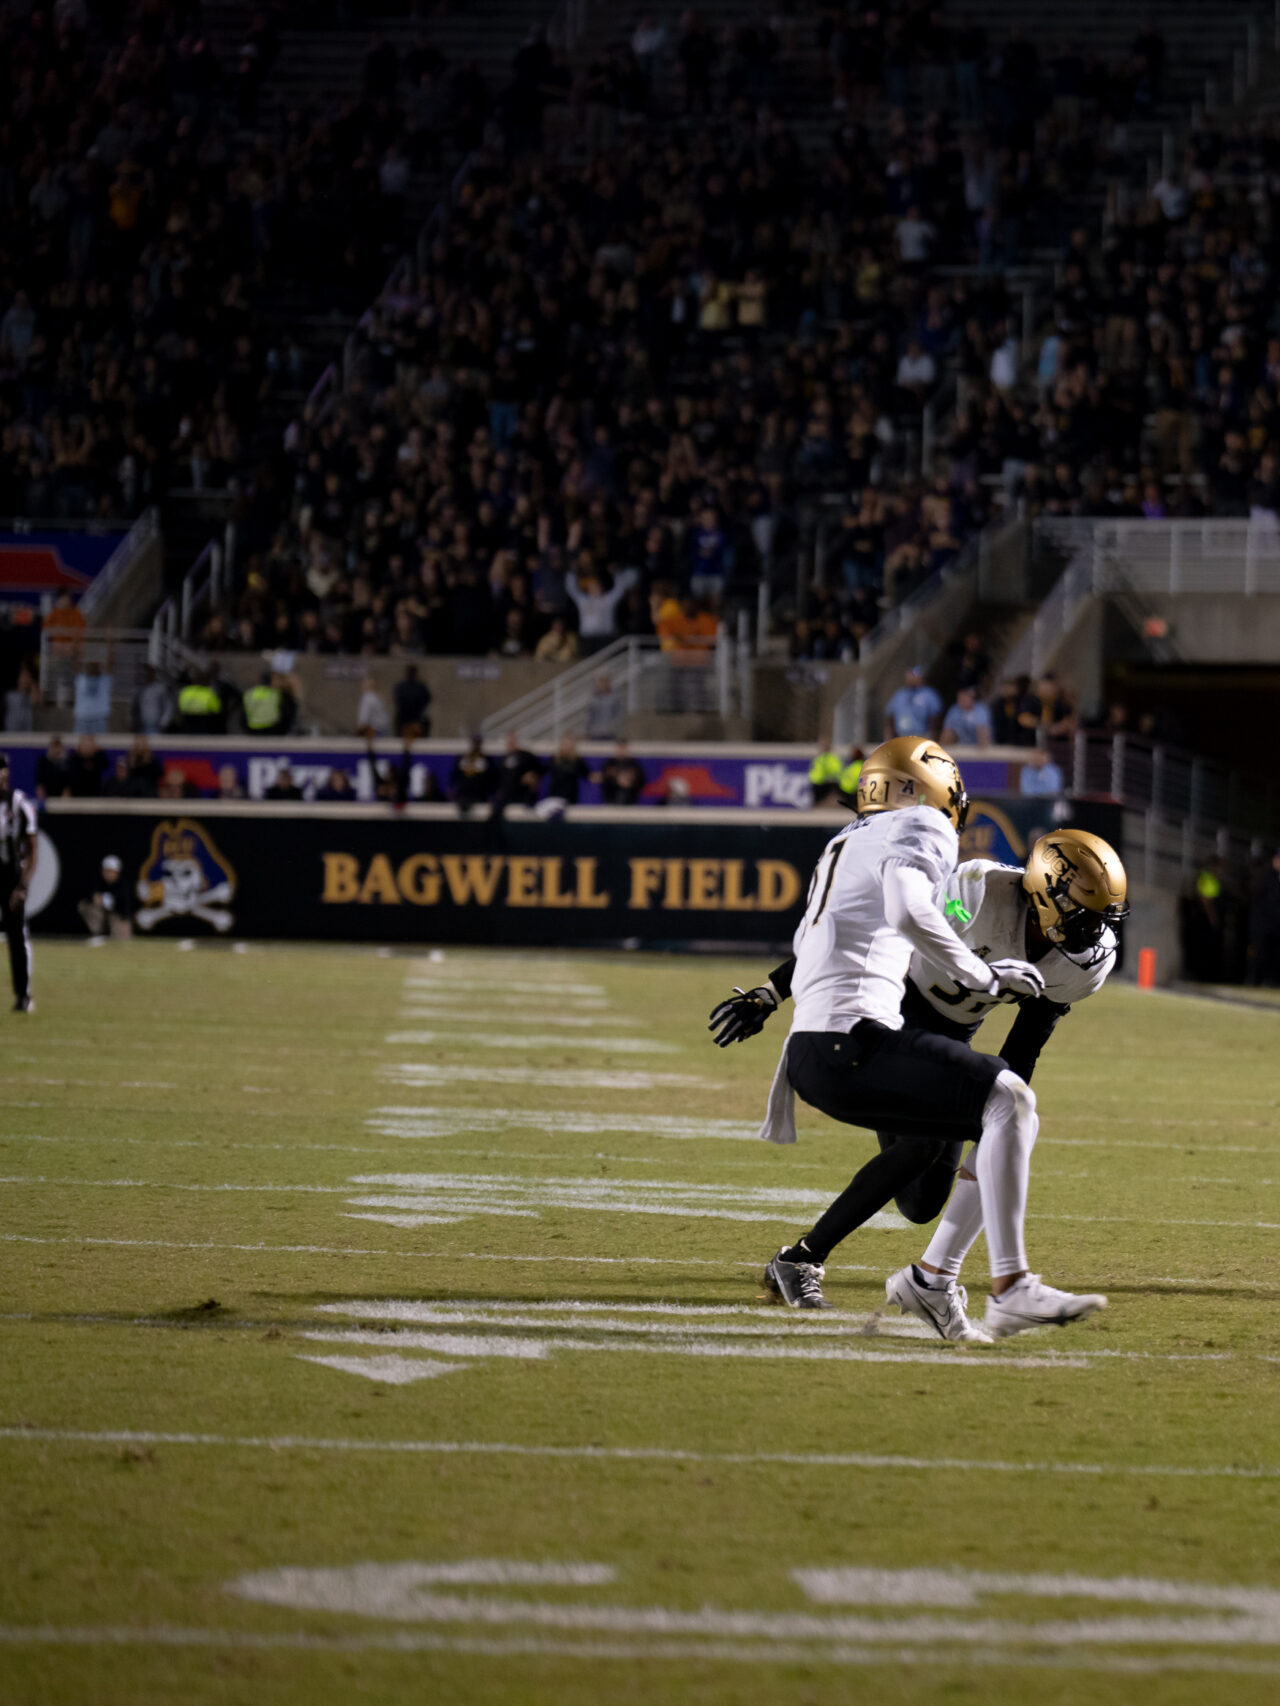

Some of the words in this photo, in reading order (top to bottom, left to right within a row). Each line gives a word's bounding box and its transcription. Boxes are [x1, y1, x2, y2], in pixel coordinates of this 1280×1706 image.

[870, 780, 890, 803] 21
[321, 851, 611, 909] BAGWELL
[627, 856, 802, 912] FIELD
